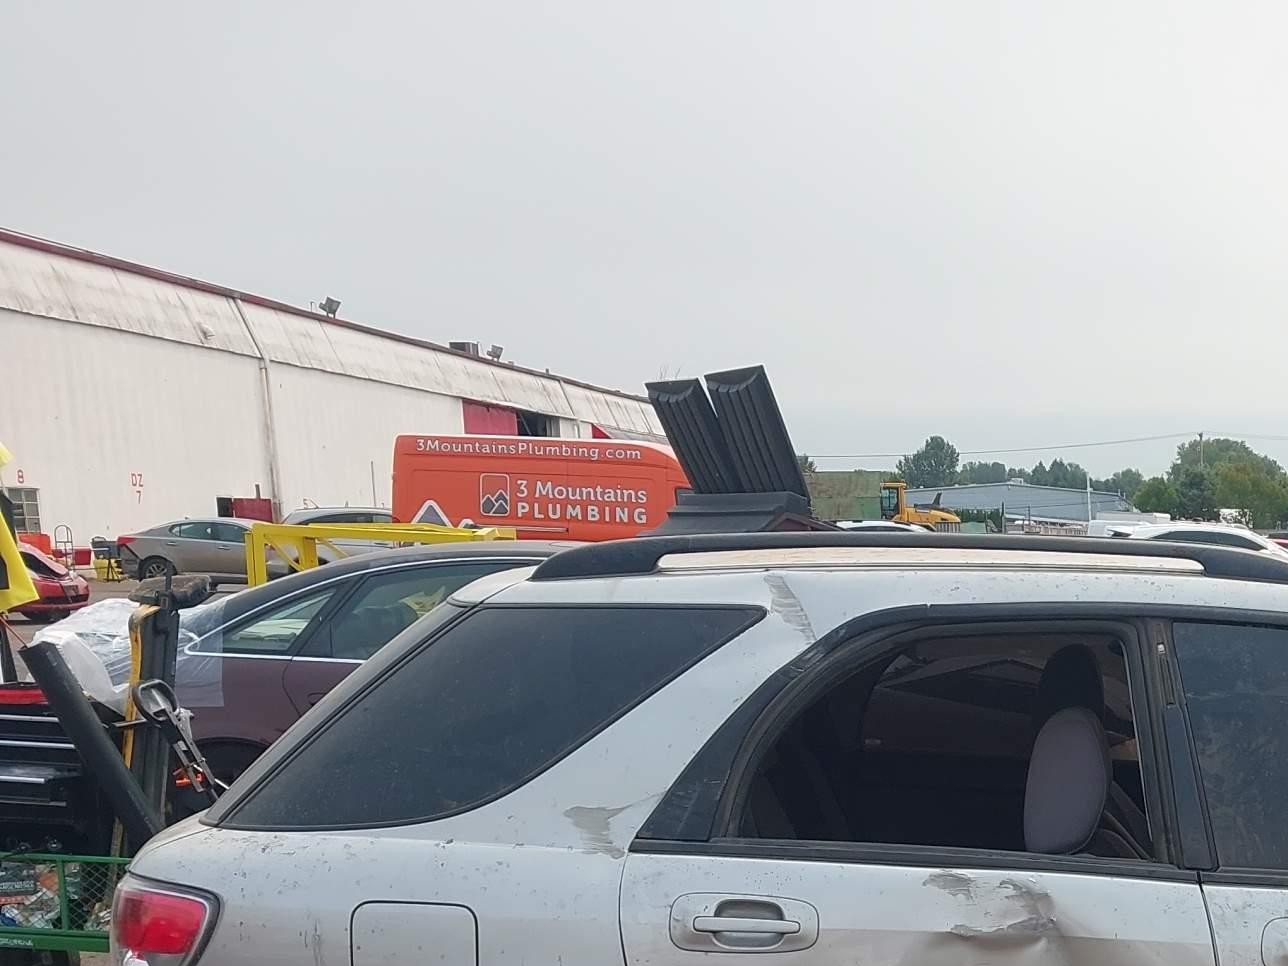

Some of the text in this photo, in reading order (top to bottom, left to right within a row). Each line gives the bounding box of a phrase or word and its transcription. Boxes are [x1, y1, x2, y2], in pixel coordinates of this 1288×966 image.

[416, 439, 641, 460] 3MountainsPlumbing.com
[17, 469, 25, 484] 8
[516, 479, 648, 503] 3 Mountains
[517, 502, 648, 524] PLUMBING
